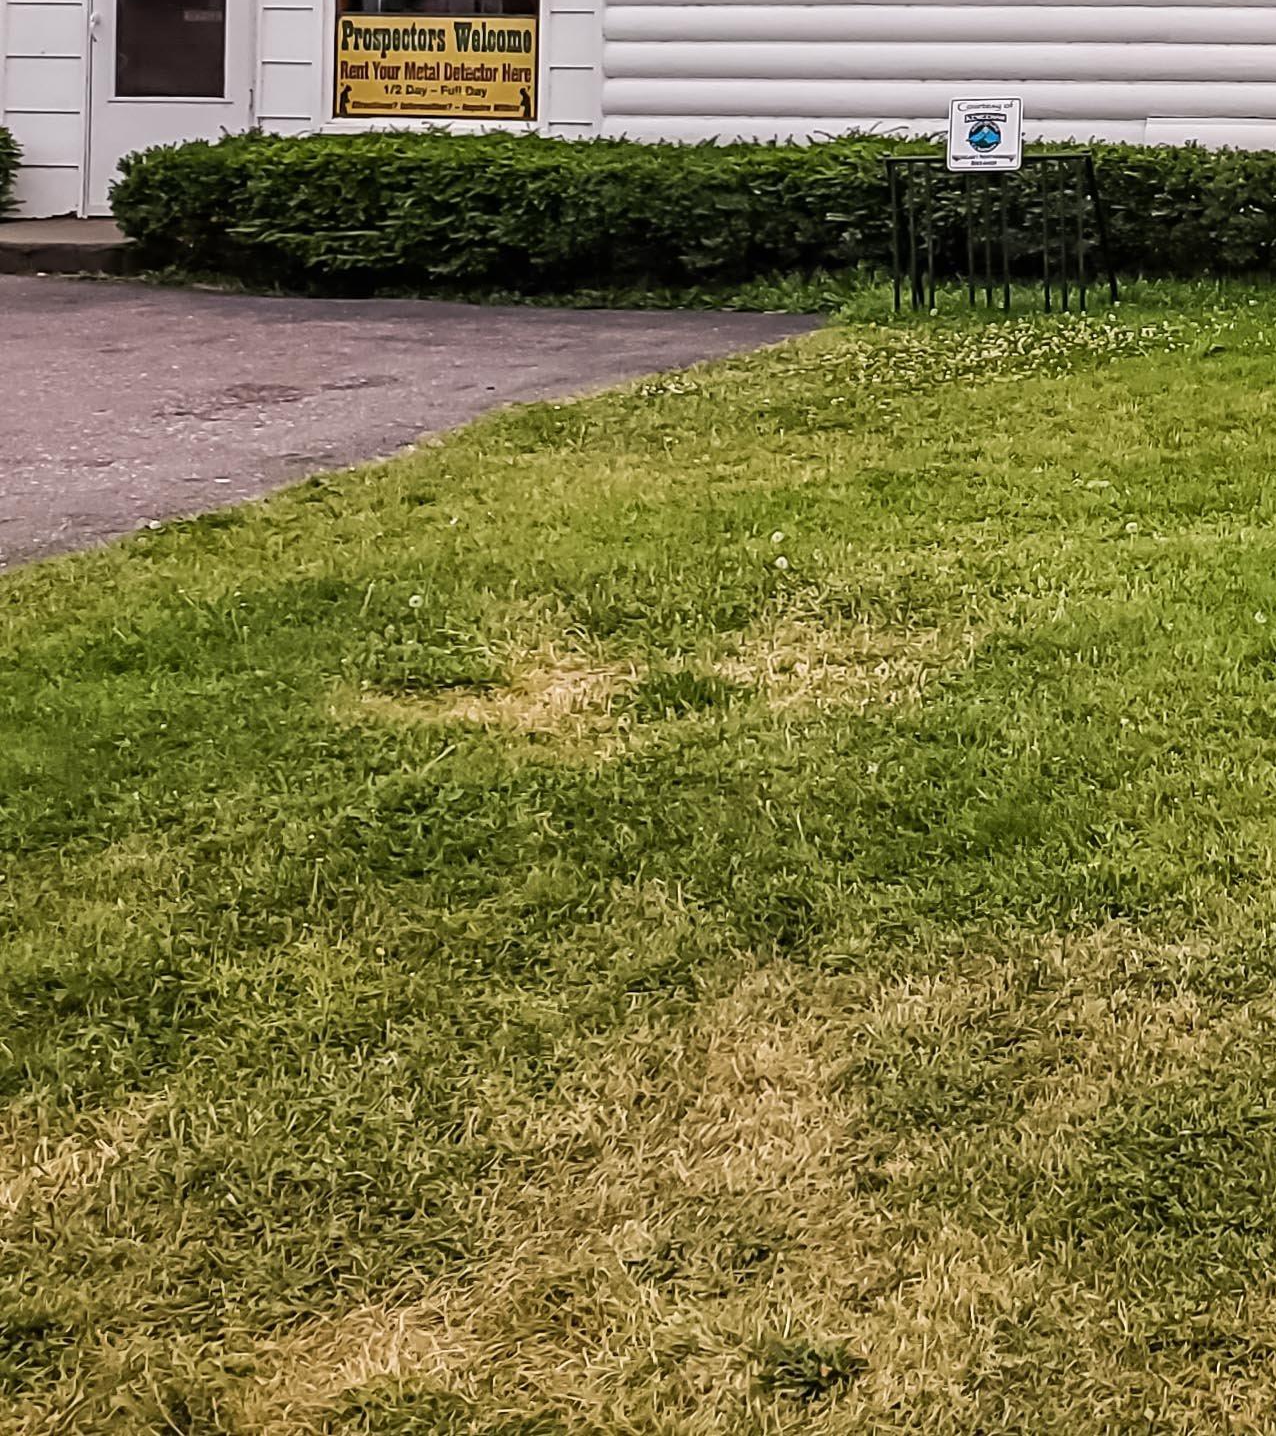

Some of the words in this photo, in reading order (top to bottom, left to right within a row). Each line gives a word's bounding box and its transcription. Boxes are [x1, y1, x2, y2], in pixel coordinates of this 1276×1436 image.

[341, 20, 446, 58] Prospectors
[453, 21, 532, 53] Welcome
[340, 60, 369, 80] Rent
[372, 61, 401, 80] Your
[404, 62, 440, 81] Metal
[444, 63, 498, 82] Detector
[502, 63, 532, 82] Here
[384, 85, 402, 95] 1/2
[405, 85, 427, 97] Day
[440, 85, 462, 95] Full
[465, 86, 488, 98] Day
